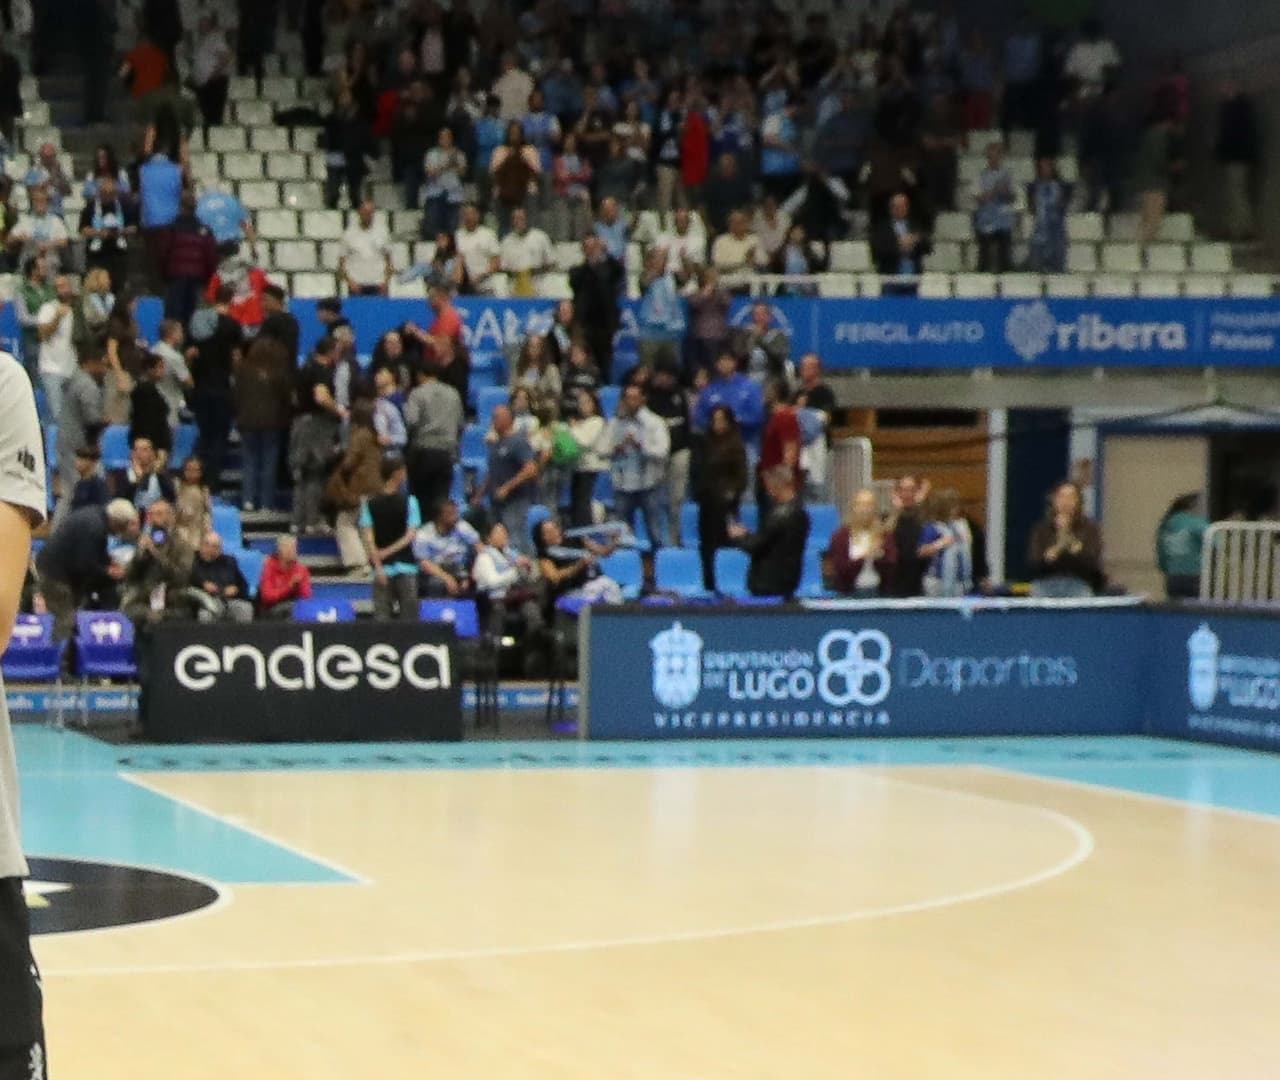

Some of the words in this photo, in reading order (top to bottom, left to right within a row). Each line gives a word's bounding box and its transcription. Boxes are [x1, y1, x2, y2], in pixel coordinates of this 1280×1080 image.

[1056, 311, 1187, 351] ribera
[175, 631, 451, 690] endesa
[897, 649, 1078, 696] Deportes
[729, 668, 815, 700] LUGO
